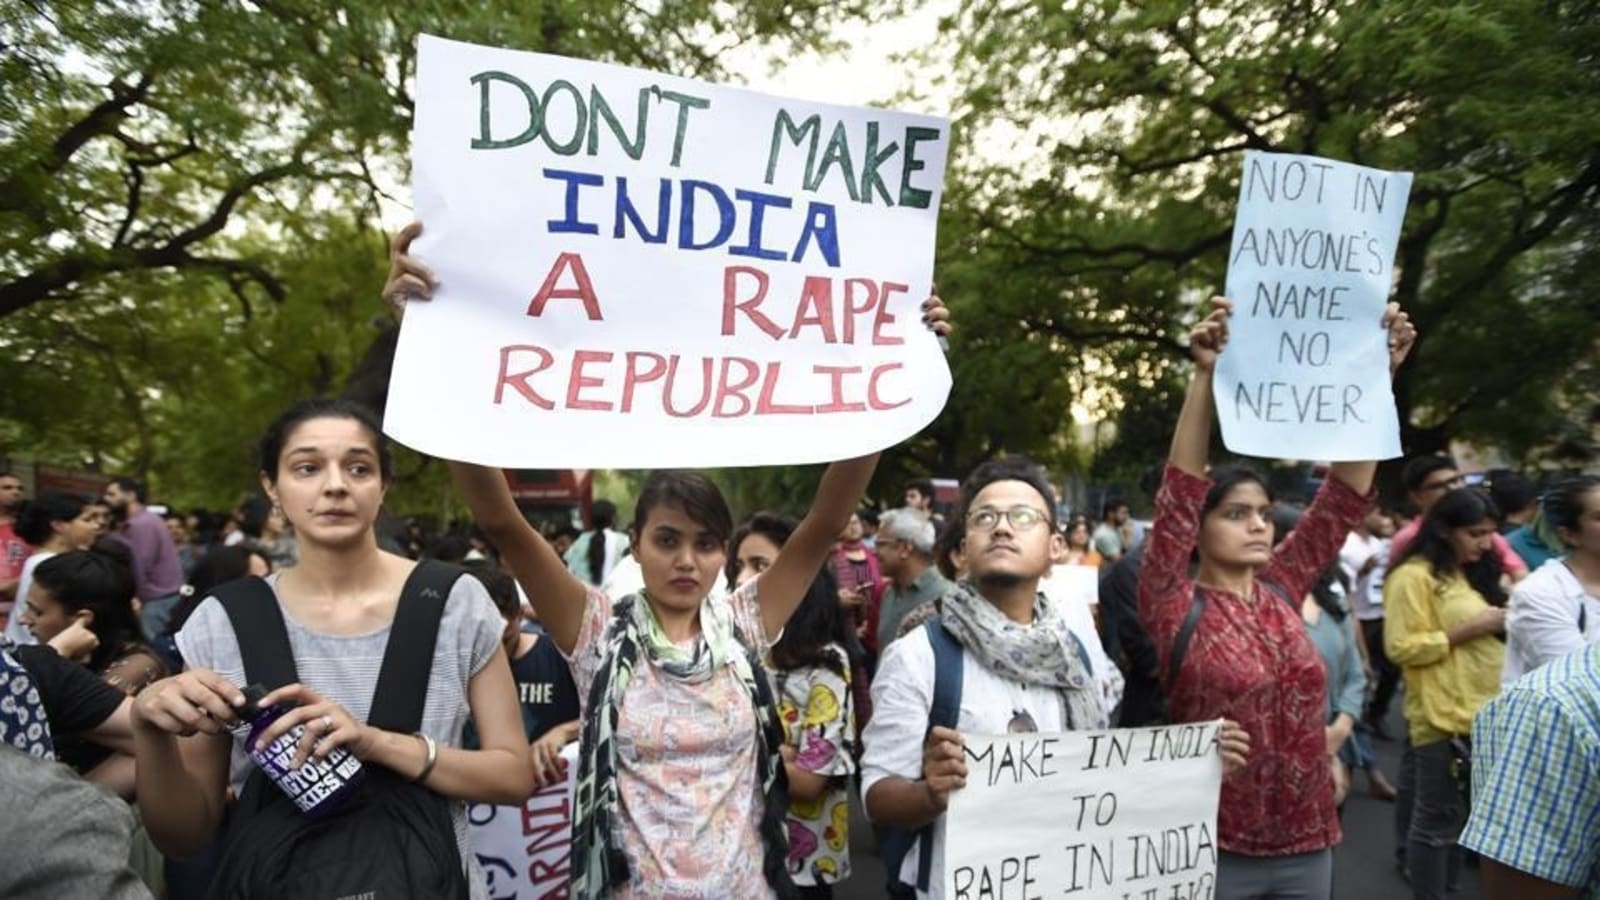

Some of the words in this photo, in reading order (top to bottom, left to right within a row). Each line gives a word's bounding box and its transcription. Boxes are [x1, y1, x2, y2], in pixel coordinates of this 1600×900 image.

[469, 70, 711, 167] DON'T
[764, 108, 939, 208] MAKE
[543, 168, 840, 267] INDIA
[1247, 159, 1334, 204] NOT
[1353, 172, 1387, 214] IN
[1233, 226, 1383, 276] ANYONE'S
[526, 252, 604, 320] A
[721, 265, 908, 346] RAPE
[494, 345, 912, 418] REPUBLIC
[519, 682, 553, 703] THE
[962, 738, 1059, 787] MAKE
[1081, 731, 1134, 771] IN
[1143, 725, 1221, 763] INDIA
[1072, 791, 1118, 832] TO
[954, 854, 1043, 900] RAPE
[1064, 839, 1114, 893] IN
[1125, 821, 1216, 881] INDIA
